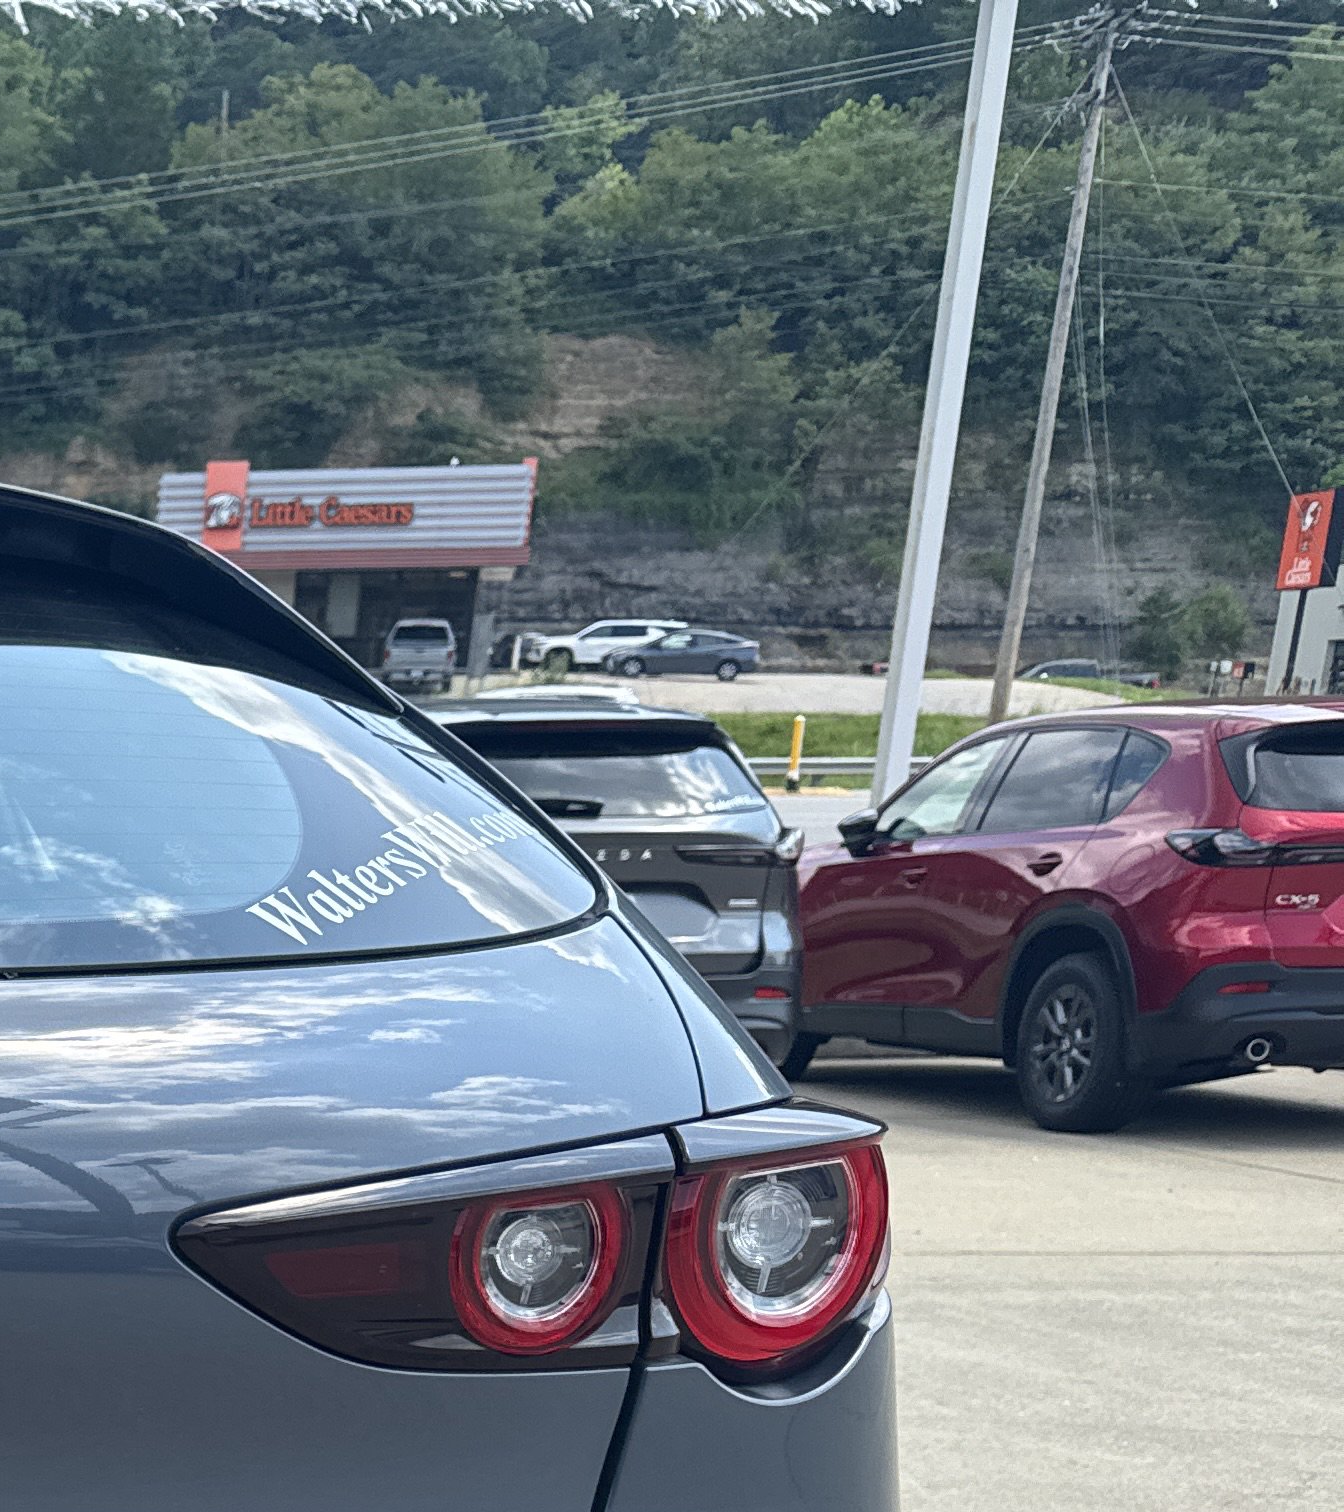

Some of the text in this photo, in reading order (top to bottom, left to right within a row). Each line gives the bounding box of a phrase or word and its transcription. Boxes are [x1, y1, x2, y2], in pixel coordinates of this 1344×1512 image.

[250, 496, 414, 527] Little Caesars
[245, 811, 540, 945] WaltersWill.com
[1275, 893, 1320, 906] CX-5
